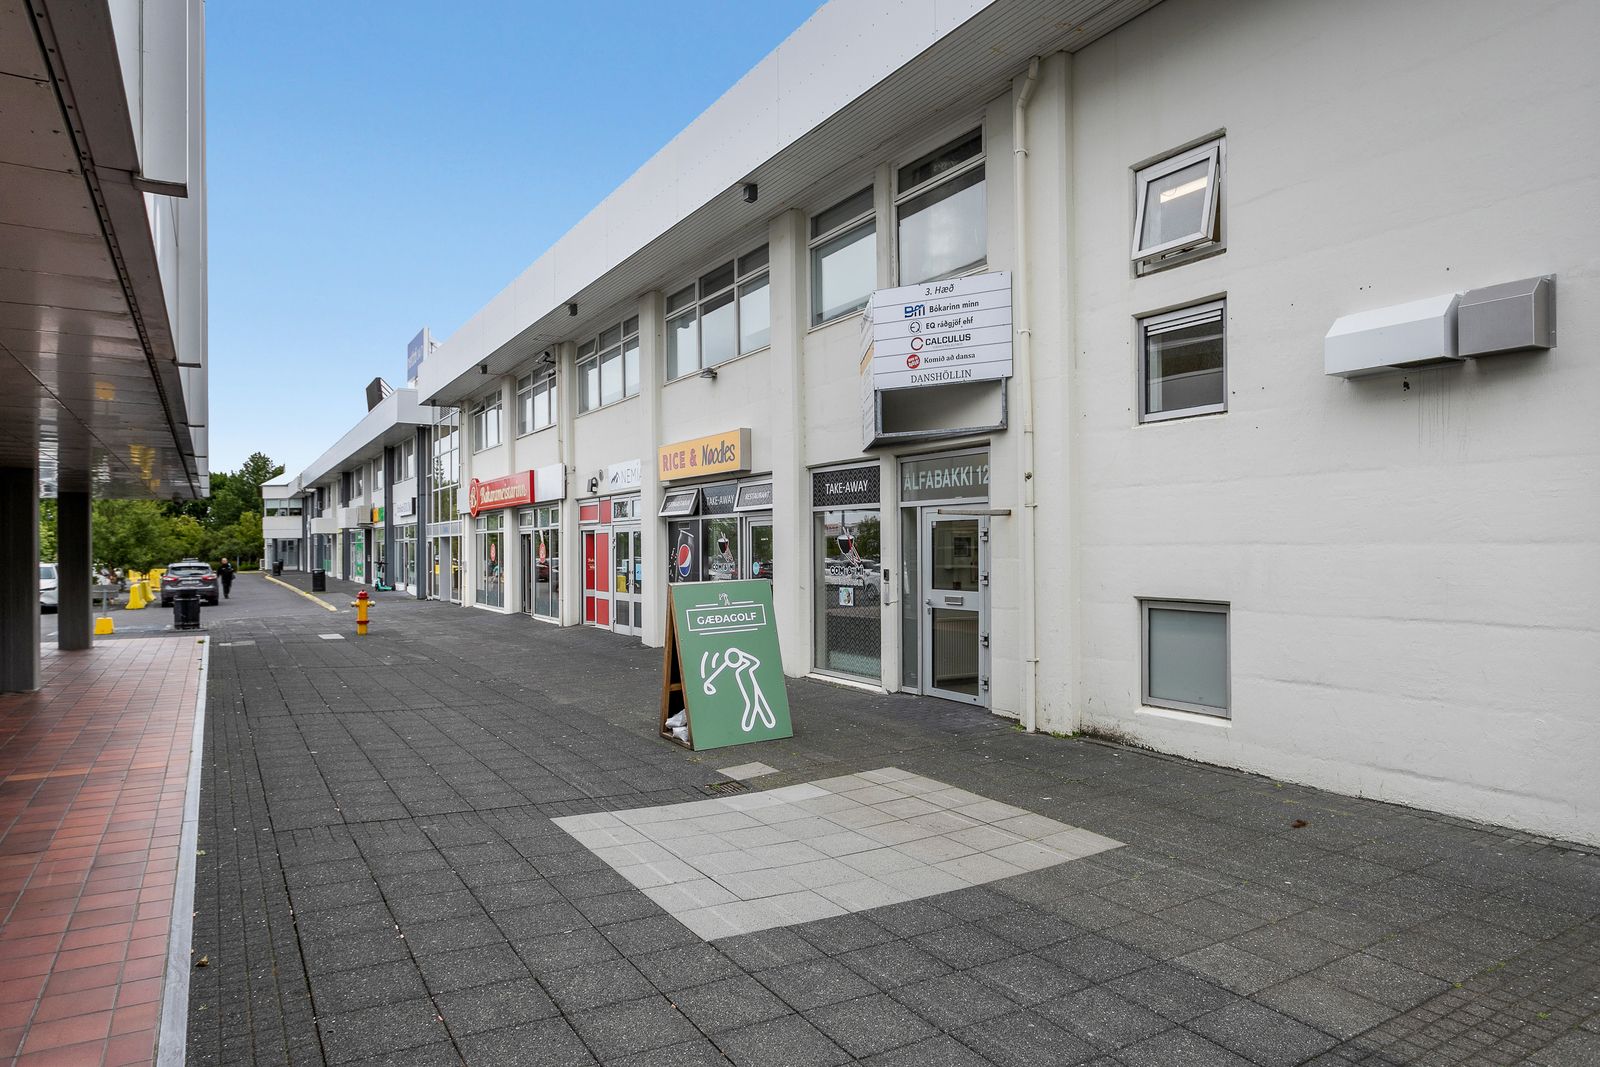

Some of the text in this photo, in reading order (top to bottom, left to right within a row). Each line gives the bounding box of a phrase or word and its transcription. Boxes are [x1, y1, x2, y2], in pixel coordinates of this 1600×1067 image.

[925, 283, 955, 296] 3. Hæð
[929, 299, 979, 313] Bókarinn minn
[925, 316, 974, 330] EQ ráðgjöf ehf
[925, 333, 971, 346] CALCULUS
[924, 355, 945, 364] Komið
[955, 352, 975, 360] dansa
[910, 369, 972, 384] DANSHÖLLIN
[662, 440, 736, 472] RICE & Noodles
[976, 464, 989, 485] 12
[825, 479, 869, 495] TAKE-AWAY
[706, 494, 735, 506] TAKE-AWAY
[696, 612, 757, 625] GÆÐAGOLF
